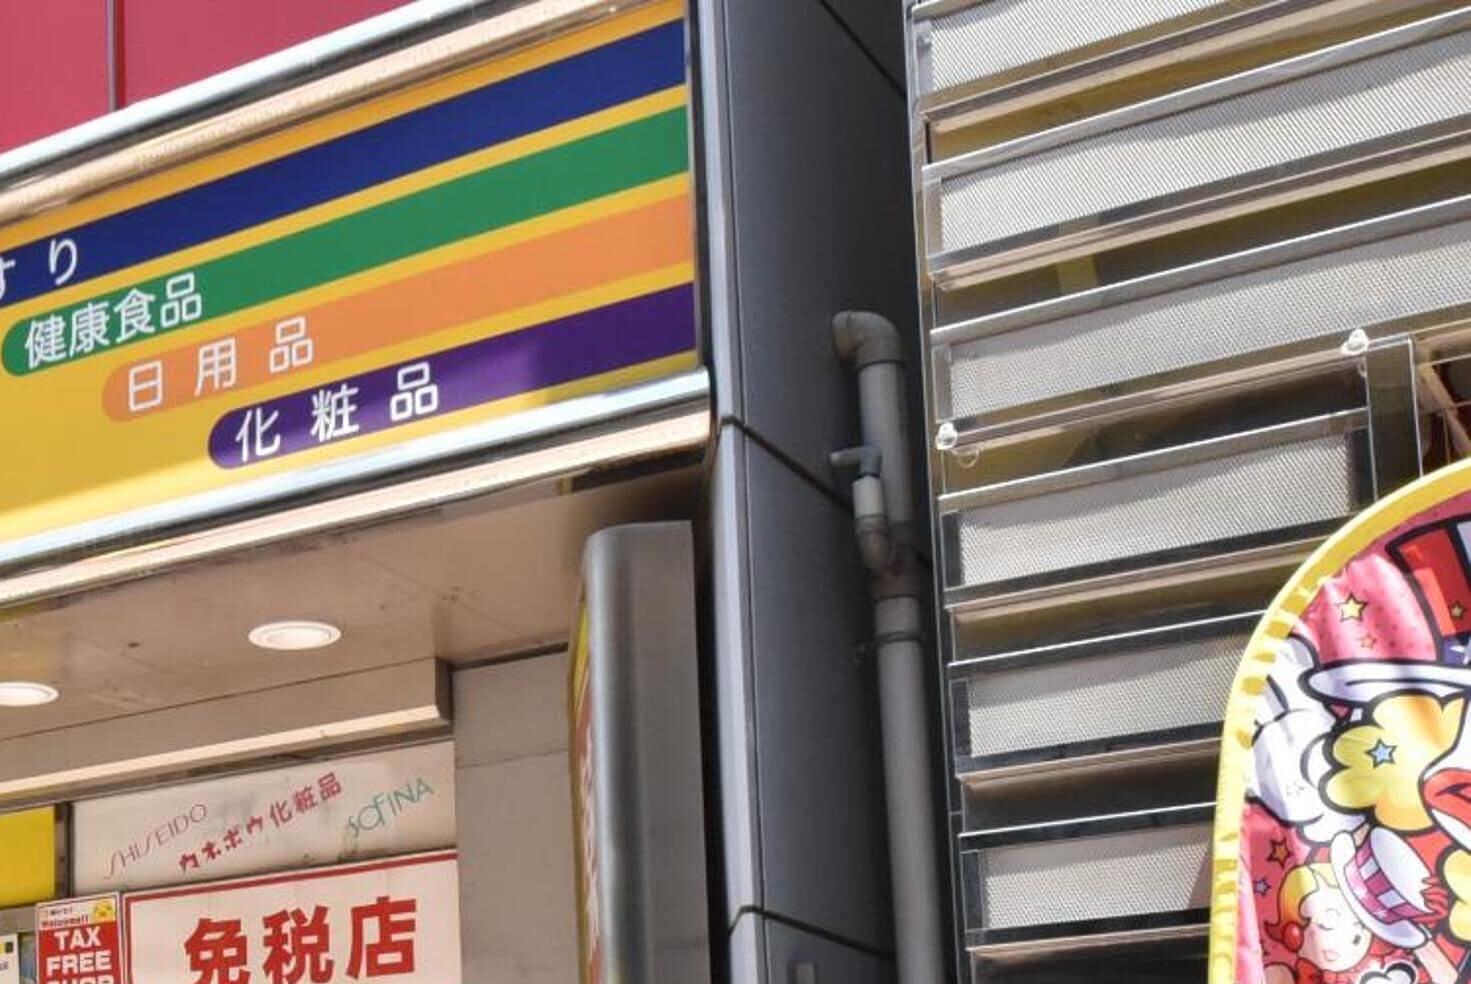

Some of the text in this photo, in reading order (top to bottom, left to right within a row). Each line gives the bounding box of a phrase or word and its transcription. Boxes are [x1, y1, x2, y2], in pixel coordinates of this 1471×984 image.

[25, 273, 203, 370] 健康食品
[129, 317, 313, 413] 日用品
[237, 362, 438, 463] 化粧品
[104, 803, 208, 880] SHISEIDO
[179, 772, 342, 874] カネボウ化粧品
[348, 779, 434, 837] SOFINA
[46, 950, 112, 976] FREE
[54, 926, 102, 951] TAX
